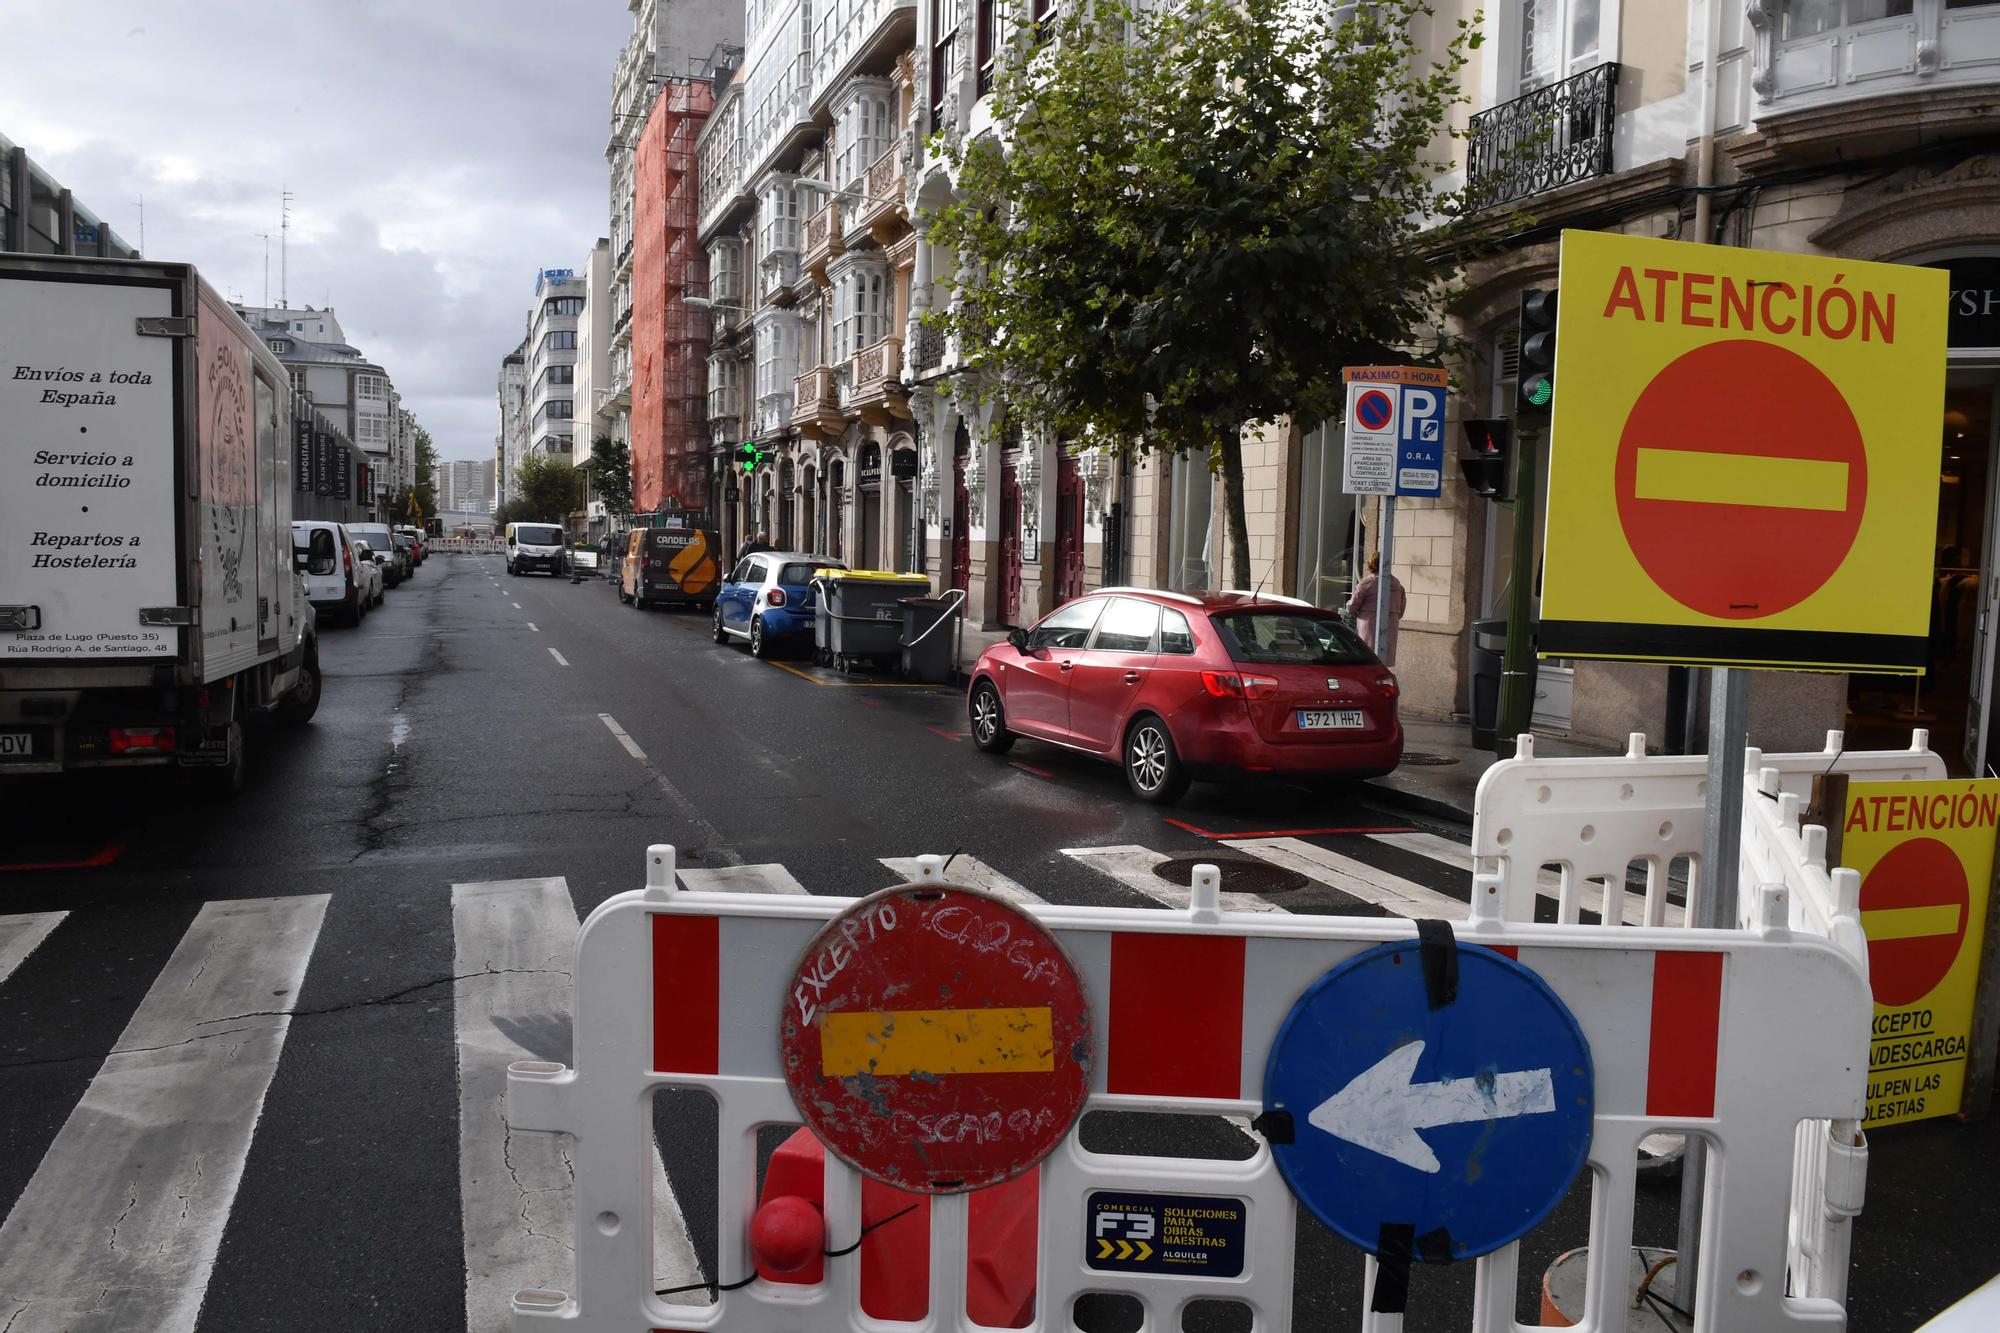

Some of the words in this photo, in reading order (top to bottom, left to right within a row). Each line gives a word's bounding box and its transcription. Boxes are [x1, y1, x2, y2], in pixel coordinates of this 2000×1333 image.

[1603, 265, 1896, 345] ATENCIÓN
[12, 366, 84, 383] Envíos
[90, 372, 102, 384] a
[109, 370, 152, 385] toda
[1351, 368, 1400, 380] MÁXIMO
[1411, 371, 1441, 383] HORA
[40, 389, 117, 408] España
[34, 450, 117, 466] Servicio
[121, 455, 134, 467] a
[1406, 451, 1434, 461] O.R.A.
[337, 448, 345, 480] Florida
[35, 473, 131, 488] domicilio
[30, 532, 123, 549] Repartos
[128, 536, 141, 546] a
[656, 535, 701, 545] CANDELAS
[32, 554, 137, 568] Hostelería
[16, 633, 45, 641] Plaza
[65, 633, 93, 643] Lugo
[96, 633, 138, 642] (Puesto
[141, 633, 160, 642] 35)
[7, 645, 28, 653] Rúa
[31, 645, 71, 654] Rodrigo
[104, 644, 151, 653] Santiago,
[1306, 712, 1337, 727] 5721
[1340, 712, 1362, 726] HHZ
[0, 735, 27, 753] DV
[1845, 784, 1998, 833] ATENCIÓN
[794, 904, 897, 1027] EXCEPTO
[1914, 1074, 1941, 1093] LAS
[1096, 1203, 1156, 1213] COMERCIAL
[1164, 1207, 1237, 1220] SOLUCIONES
[1095, 1211, 1155, 1240] F3
[1164, 1217, 1194, 1228] PARA
[1164, 1226, 1204, 1236] OBRAS
[1163, 1235, 1227, 1248] MAESTRAS
[1163, 1250, 1207, 1260] ALQUILER
